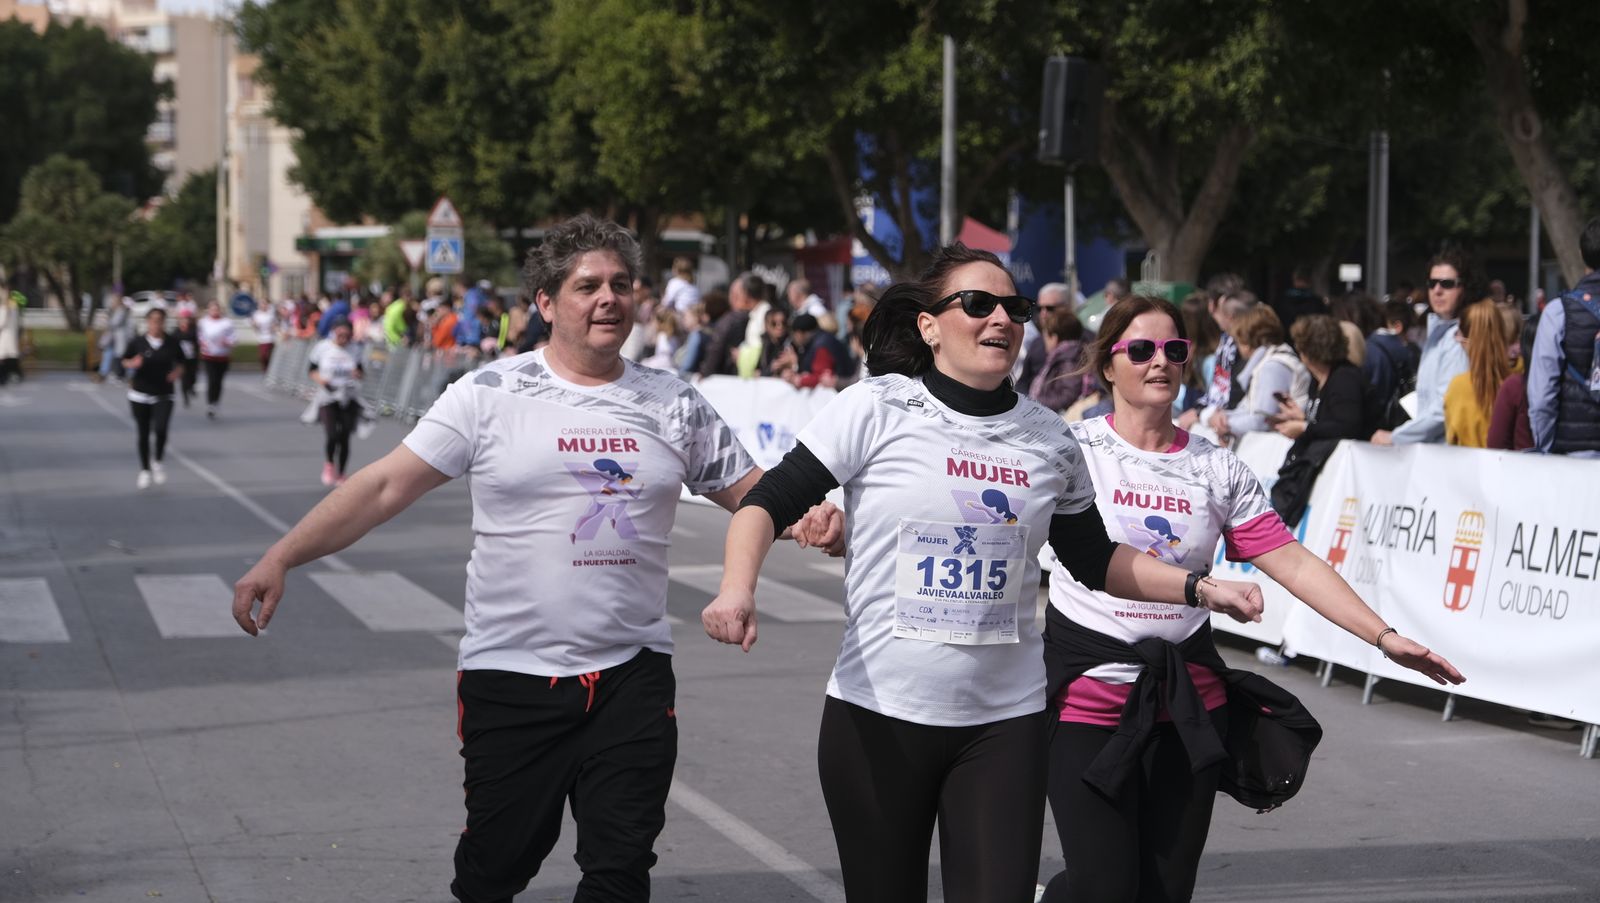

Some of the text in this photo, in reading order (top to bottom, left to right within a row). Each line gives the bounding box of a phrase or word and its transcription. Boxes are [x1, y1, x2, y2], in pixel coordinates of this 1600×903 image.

[561, 427, 631, 436] CARRERA DE LA
[557, 437, 640, 453] MUJER
[950, 447, 1022, 467] CARRERA DE LA
[946, 457, 1031, 488] MUJER
[1119, 479, 1186, 496] CARRERA DE LA
[1113, 488, 1193, 516] MUJER
[917, 535, 949, 546] MUJER
[584, 549, 631, 558] LA IGUALDAD
[572, 559, 582, 567] ES
[583, 558, 619, 566] NUESTRA
[916, 555, 1008, 592] 1315
[916, 587, 1004, 600] JAVIEVAALVARLEO
[1498, 580, 1569, 620] CIUDAD
[1126, 602, 1175, 611] LA IGUALDAD
[1114, 610, 1125, 618] ES
[1126, 611, 1163, 620] NUESTRA
